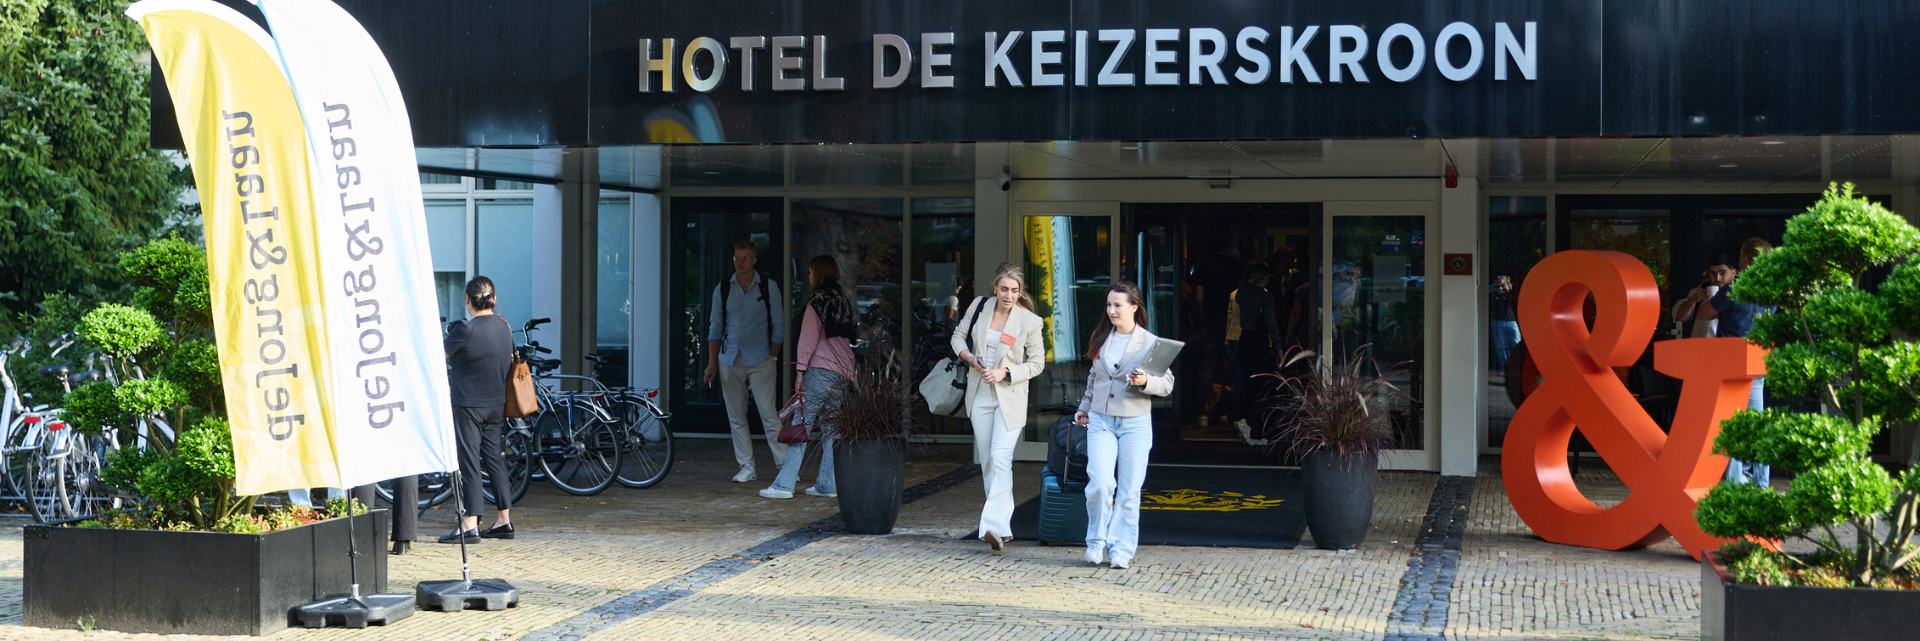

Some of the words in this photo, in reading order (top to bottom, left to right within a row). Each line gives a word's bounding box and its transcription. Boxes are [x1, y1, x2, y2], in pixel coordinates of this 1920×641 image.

[638, 34, 846, 93] HOTEL
[872, 31, 956, 90] DE
[984, 20, 1538, 88] KEIZERSKROON
